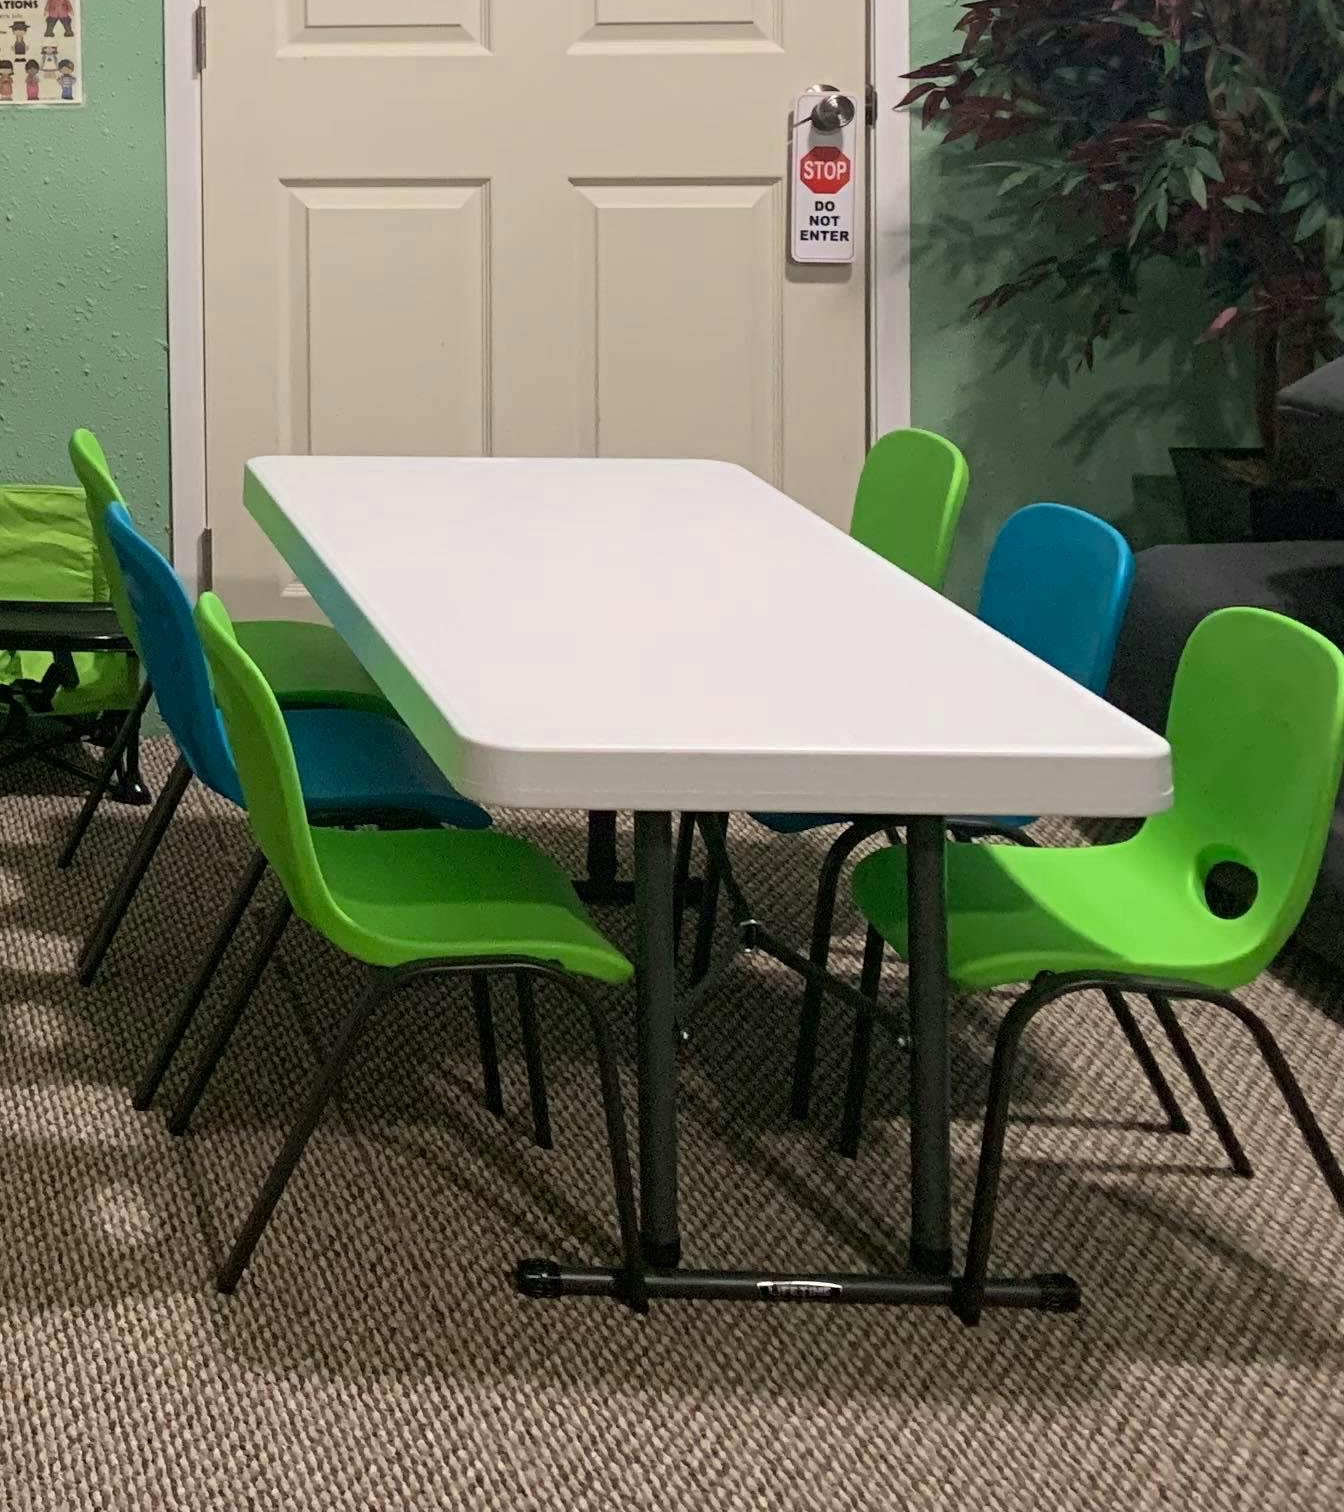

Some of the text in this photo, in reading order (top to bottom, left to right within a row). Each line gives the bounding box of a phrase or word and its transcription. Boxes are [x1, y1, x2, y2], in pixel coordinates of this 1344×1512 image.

[803, 161, 848, 181] STOP
[815, 201, 835, 212] DO
[809, 216, 840, 226] NOT
[800, 230, 849, 242] ENTER
